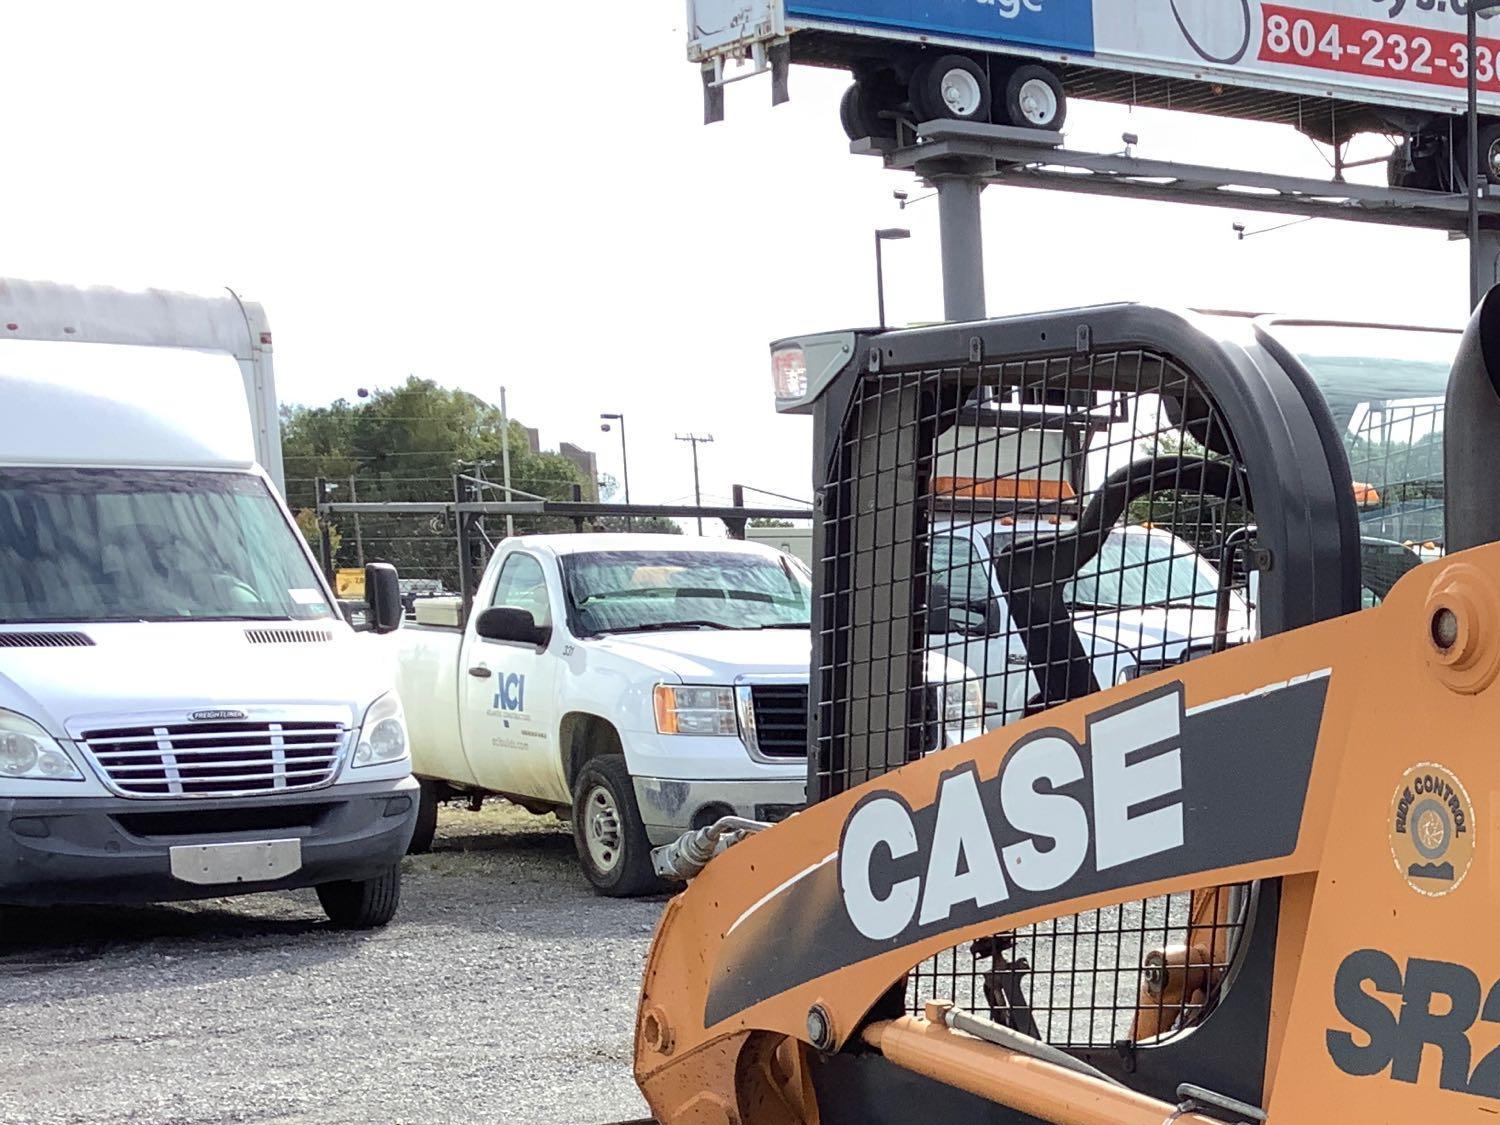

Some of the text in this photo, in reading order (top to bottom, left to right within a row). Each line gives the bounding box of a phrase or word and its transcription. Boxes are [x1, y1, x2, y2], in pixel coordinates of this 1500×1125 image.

[842, 692, 1183, 939] CASE
[1396, 774, 1467, 838] RIDE CONTROL
